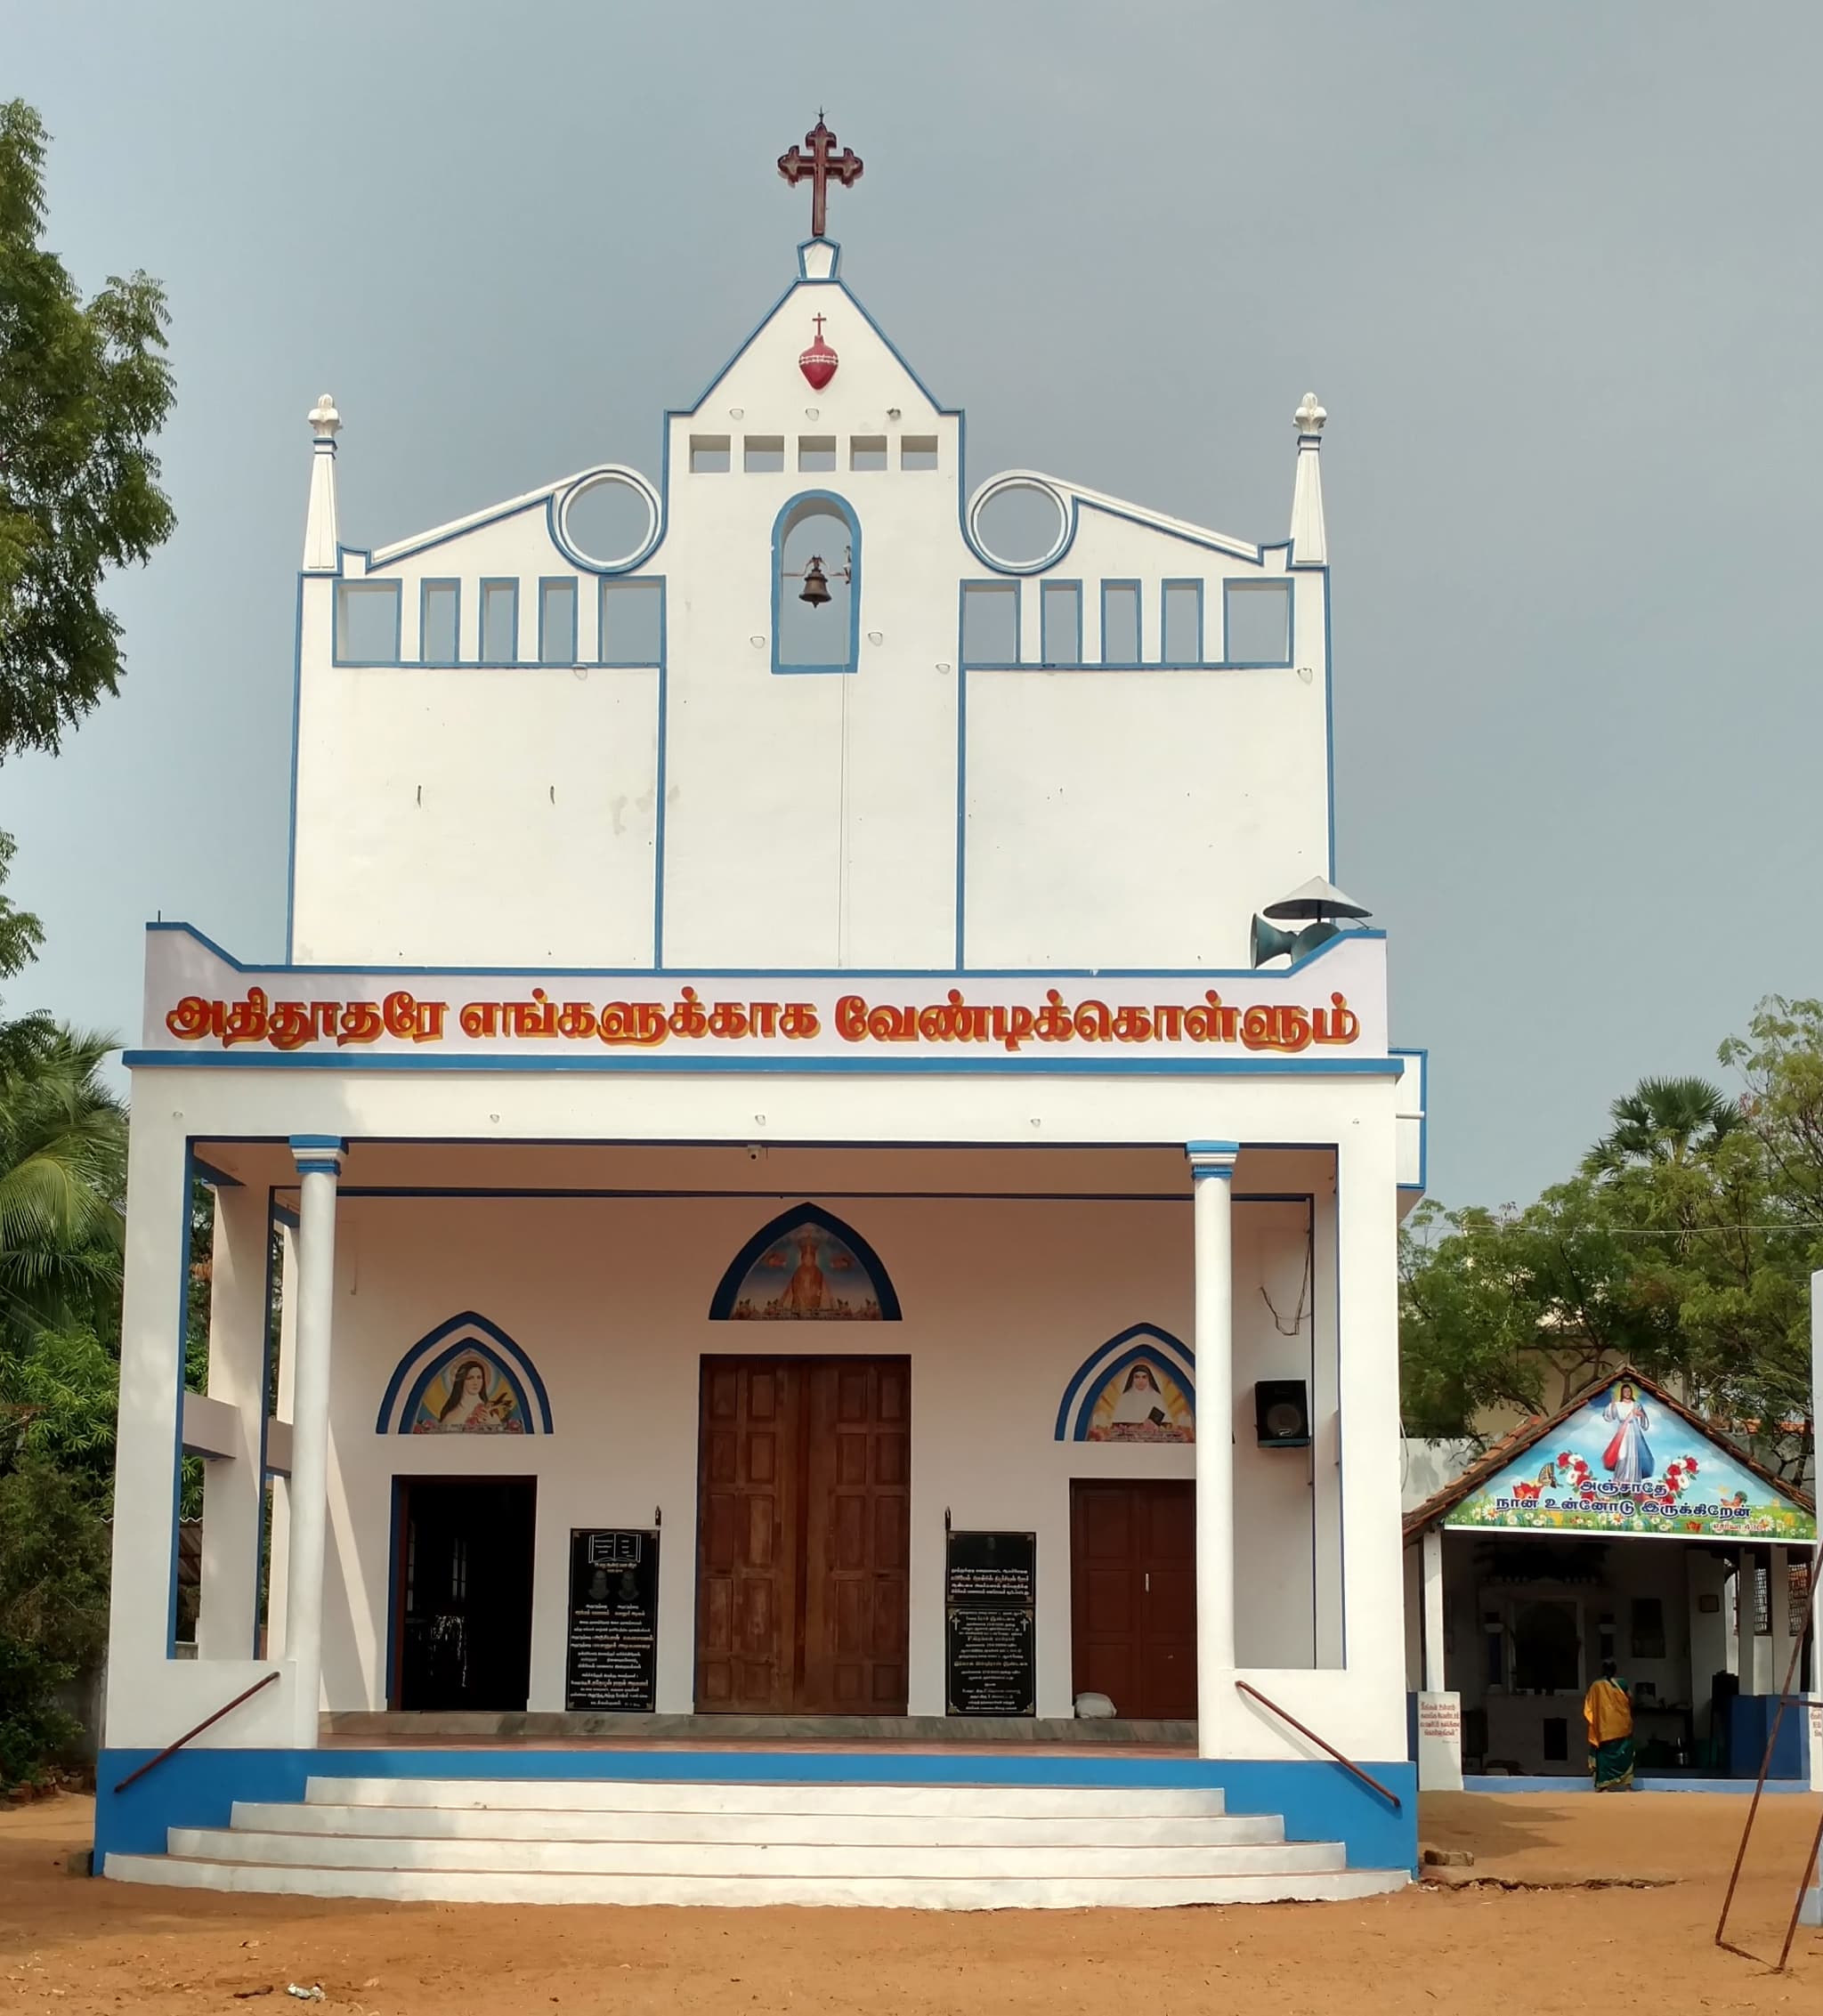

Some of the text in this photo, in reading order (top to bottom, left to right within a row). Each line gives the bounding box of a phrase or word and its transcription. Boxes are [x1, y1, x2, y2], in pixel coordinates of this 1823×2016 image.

[166, 986, 1360, 1053] அதிதூதரே எங்களுக்காக வேண்டிக்கொள்ளும்
[1580, 1478, 1668, 1497] அஞ்சாதே
[1496, 1495, 1753, 1522] நான் உன்னோடு இருக்கிறேன்
